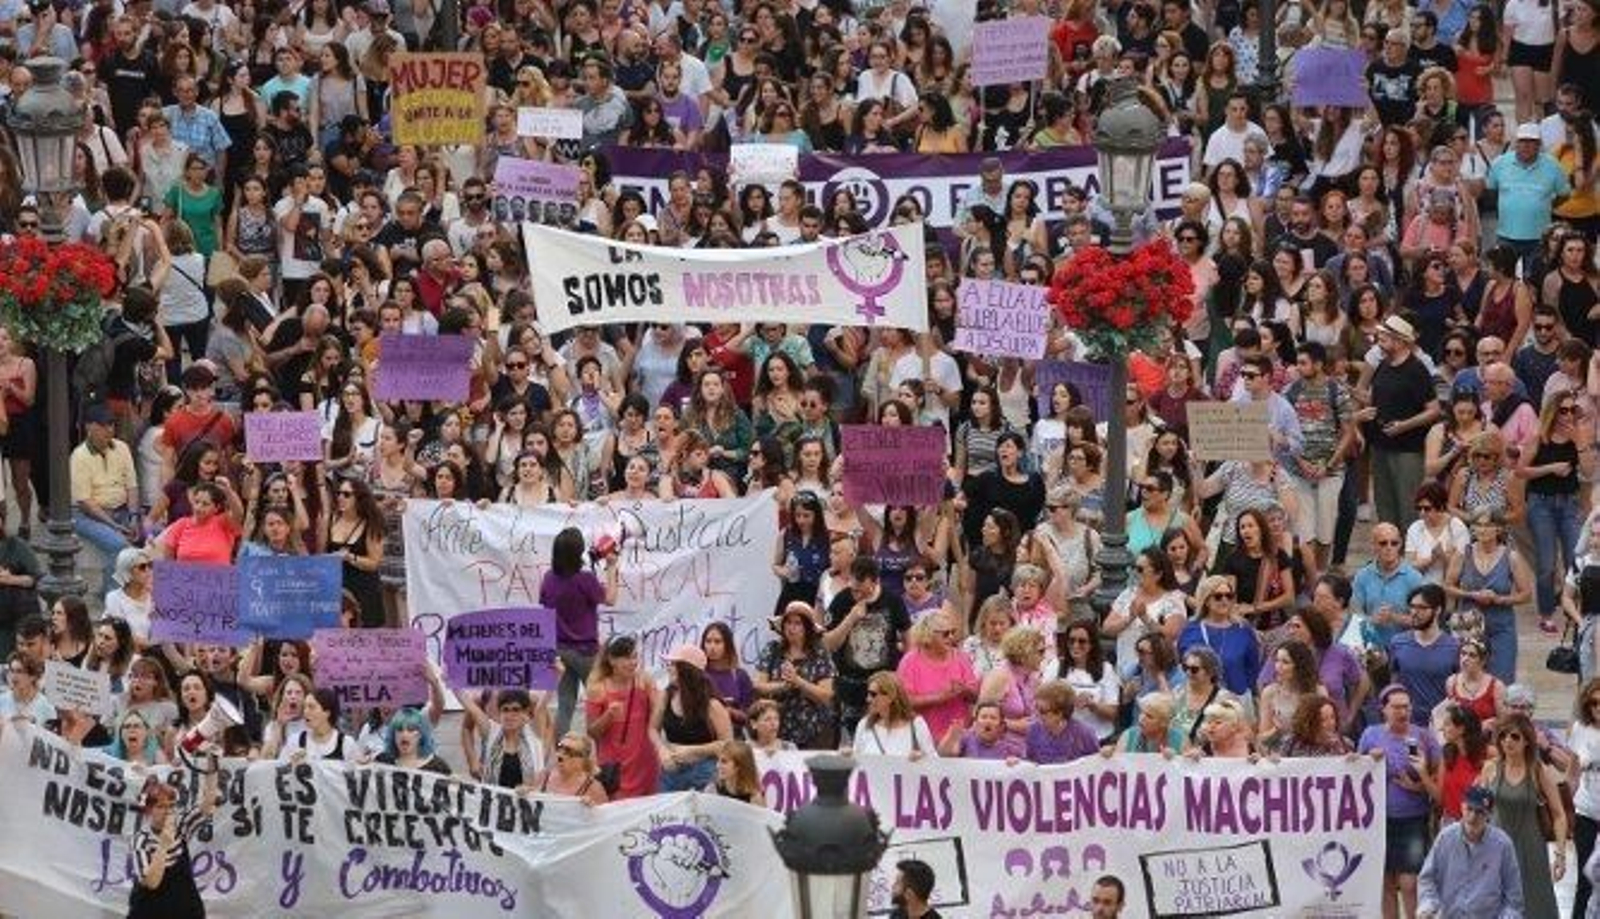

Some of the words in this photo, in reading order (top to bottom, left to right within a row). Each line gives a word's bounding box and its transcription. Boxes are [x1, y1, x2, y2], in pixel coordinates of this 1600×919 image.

[391, 58, 480, 97] MUJER
[563, 272, 663, 314] SOMOS
[683, 271, 821, 308] NOSOTRAS
[29, 737, 70, 775] NO
[85, 761, 128, 797] ES
[276, 763, 317, 806] ES
[894, 772, 954, 830] LAS
[970, 770, 1168, 835] VIOLENCIAS
[1184, 770, 1376, 835] MACHISTAS
[279, 804, 315, 845] TE
[1179, 873, 1257, 899] JUSTICIA
